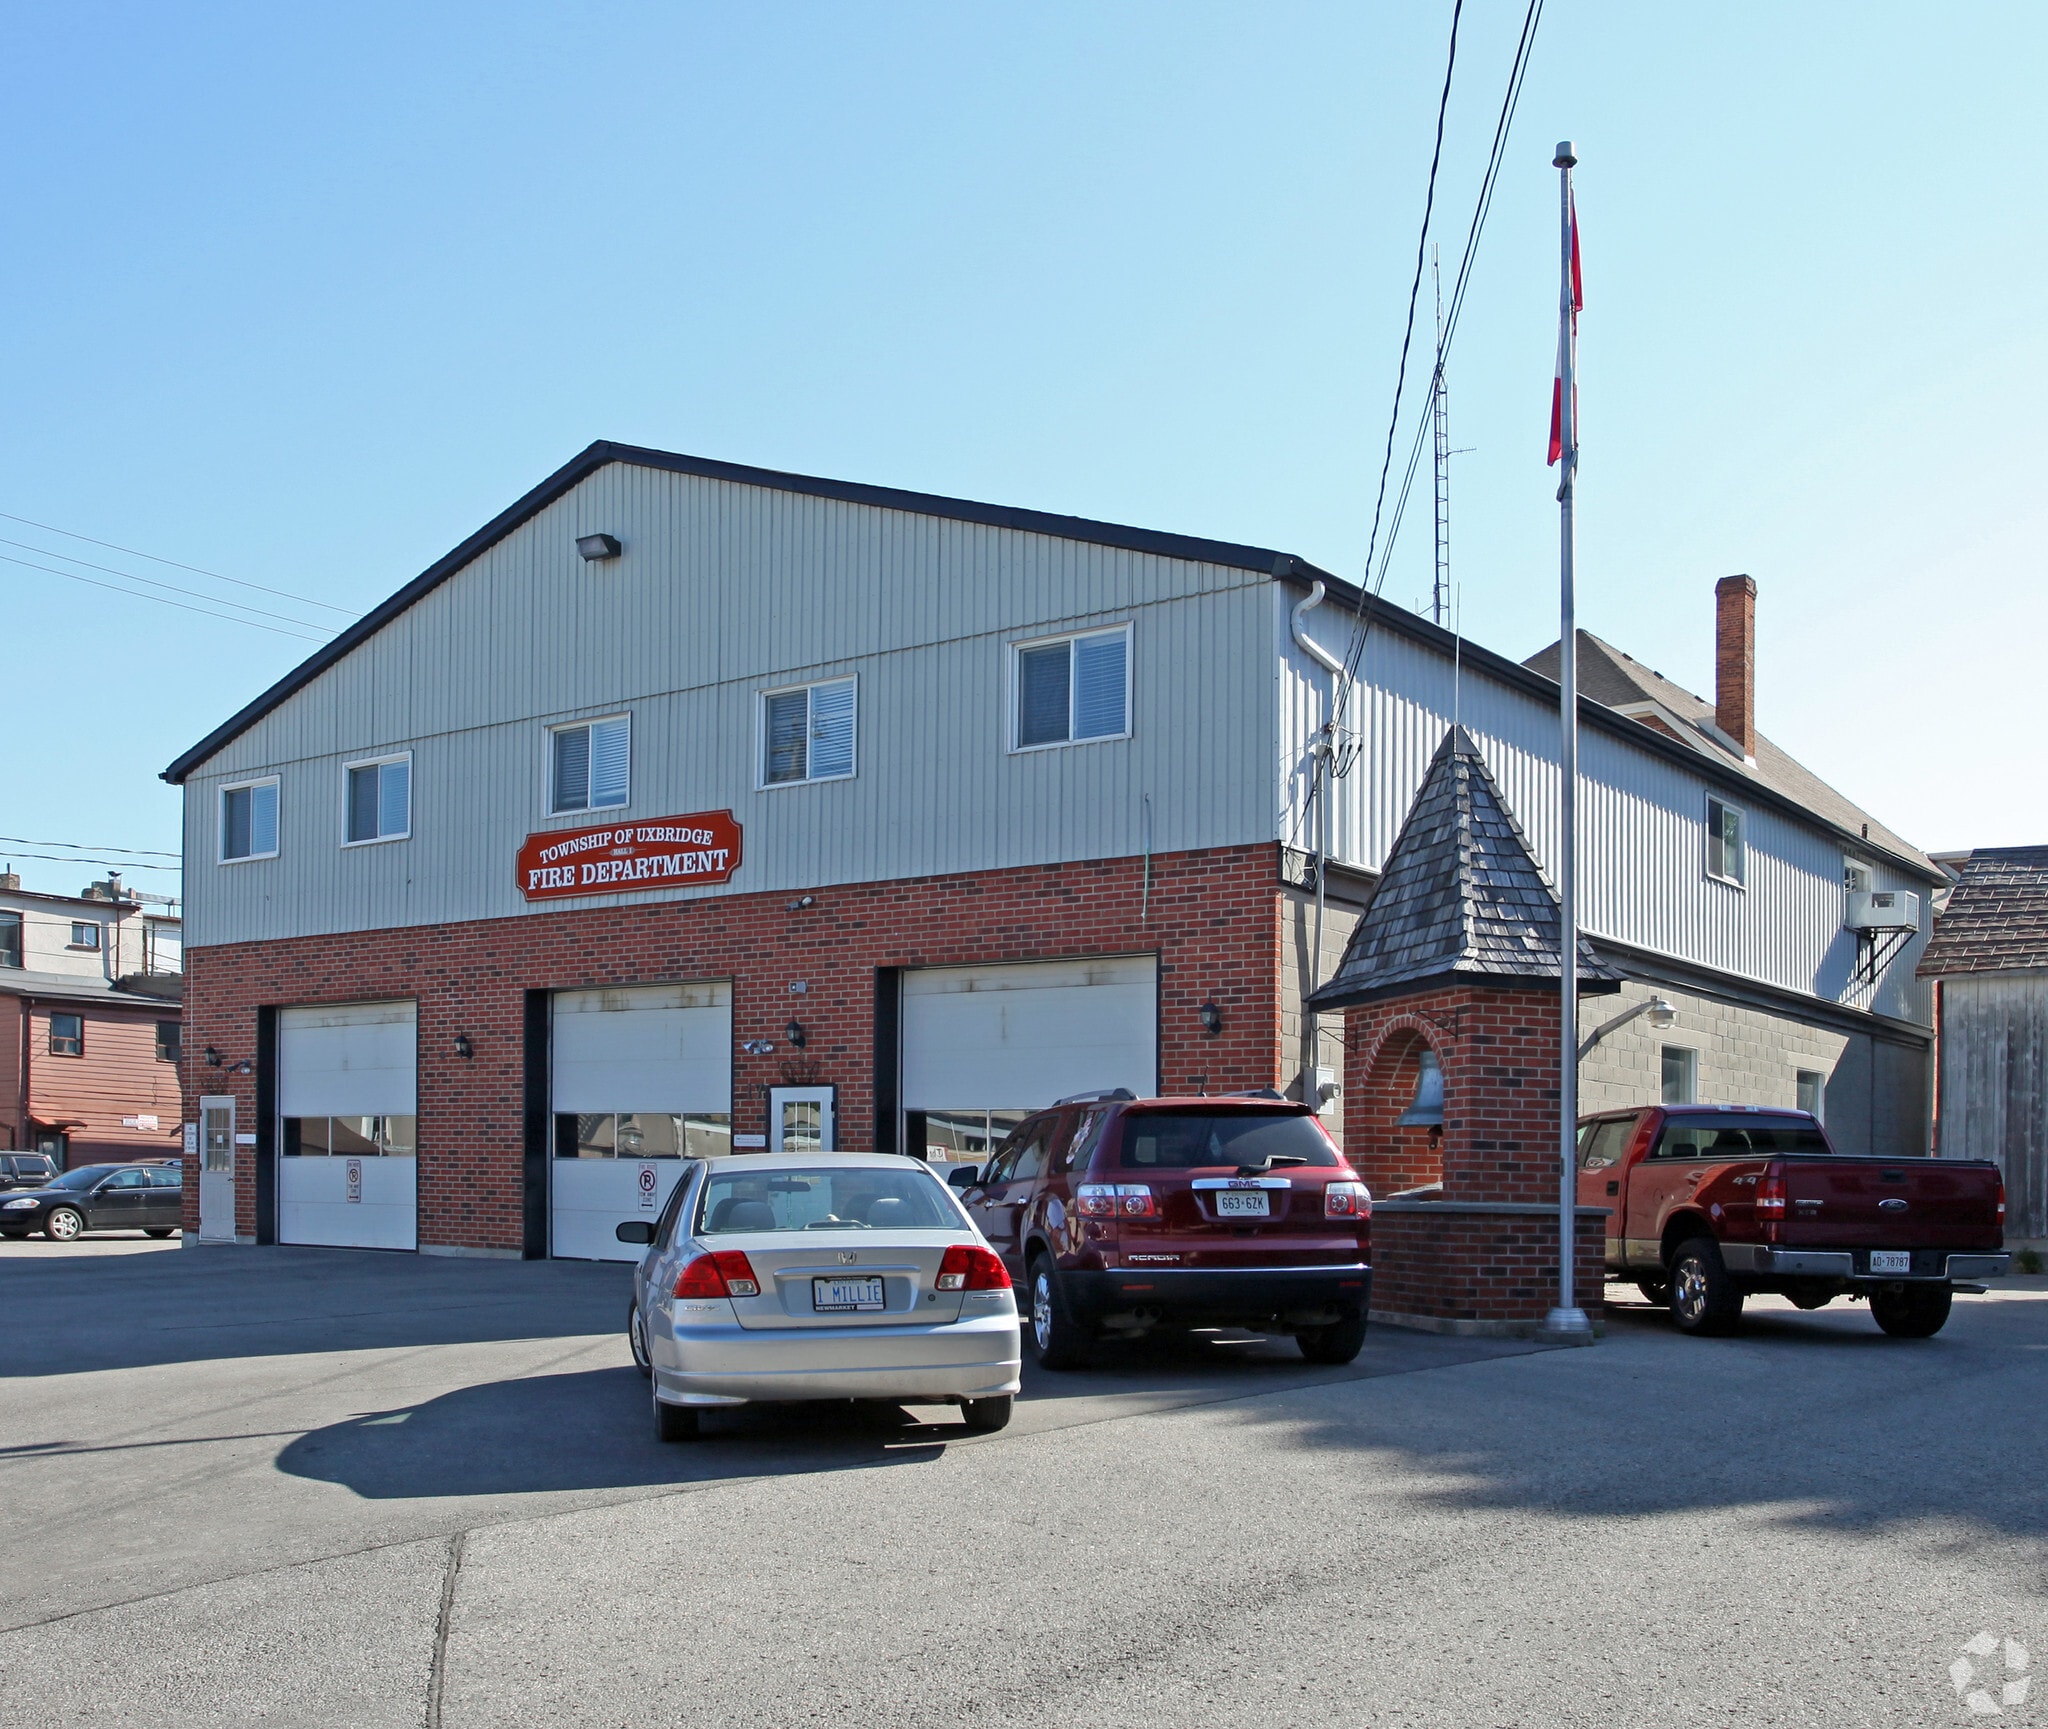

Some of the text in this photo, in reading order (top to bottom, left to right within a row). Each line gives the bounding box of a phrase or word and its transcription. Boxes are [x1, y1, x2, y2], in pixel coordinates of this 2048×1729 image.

[540, 827, 713, 864] TOWNSHIP OF UXBRIDGE
[528, 848, 729, 890] FIRE DEPARTMENT
[1228, 1180, 1260, 1188] GMC
[832, 1285, 881, 1303] MILLIE
